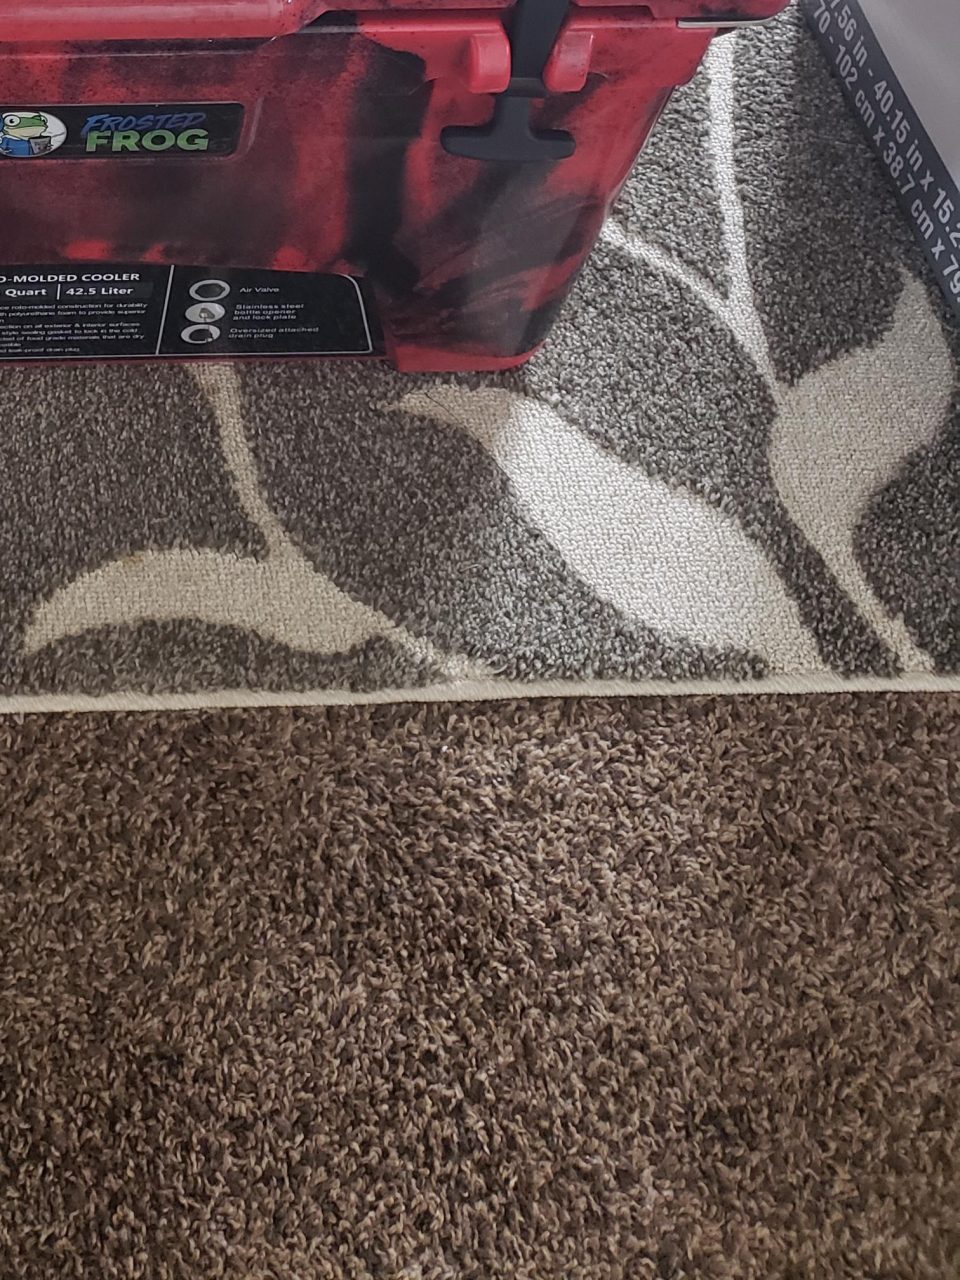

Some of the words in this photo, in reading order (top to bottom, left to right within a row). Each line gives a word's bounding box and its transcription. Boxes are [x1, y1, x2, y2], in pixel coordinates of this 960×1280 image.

[80, 112, 207, 139] FROSTED
[852, 35, 870, 68] in
[873, 79, 911, 145] 40.15
[906, 139, 924, 172] in
[920, 170, 935, 192] x
[85, 129, 209, 152] FROG
[835, 43, 859, 90] 102
[854, 88, 875, 127] cm
[871, 127, 887, 148] x
[883, 141, 916, 196] 38.7
[911, 198, 934, 240] cm
[931, 238, 946, 261] x
[81, 273, 140, 282] COOLER
[5, 287, 47, 297] Quart
[66, 287, 96, 295] 42.5
[101, 286, 133, 295] Liter
